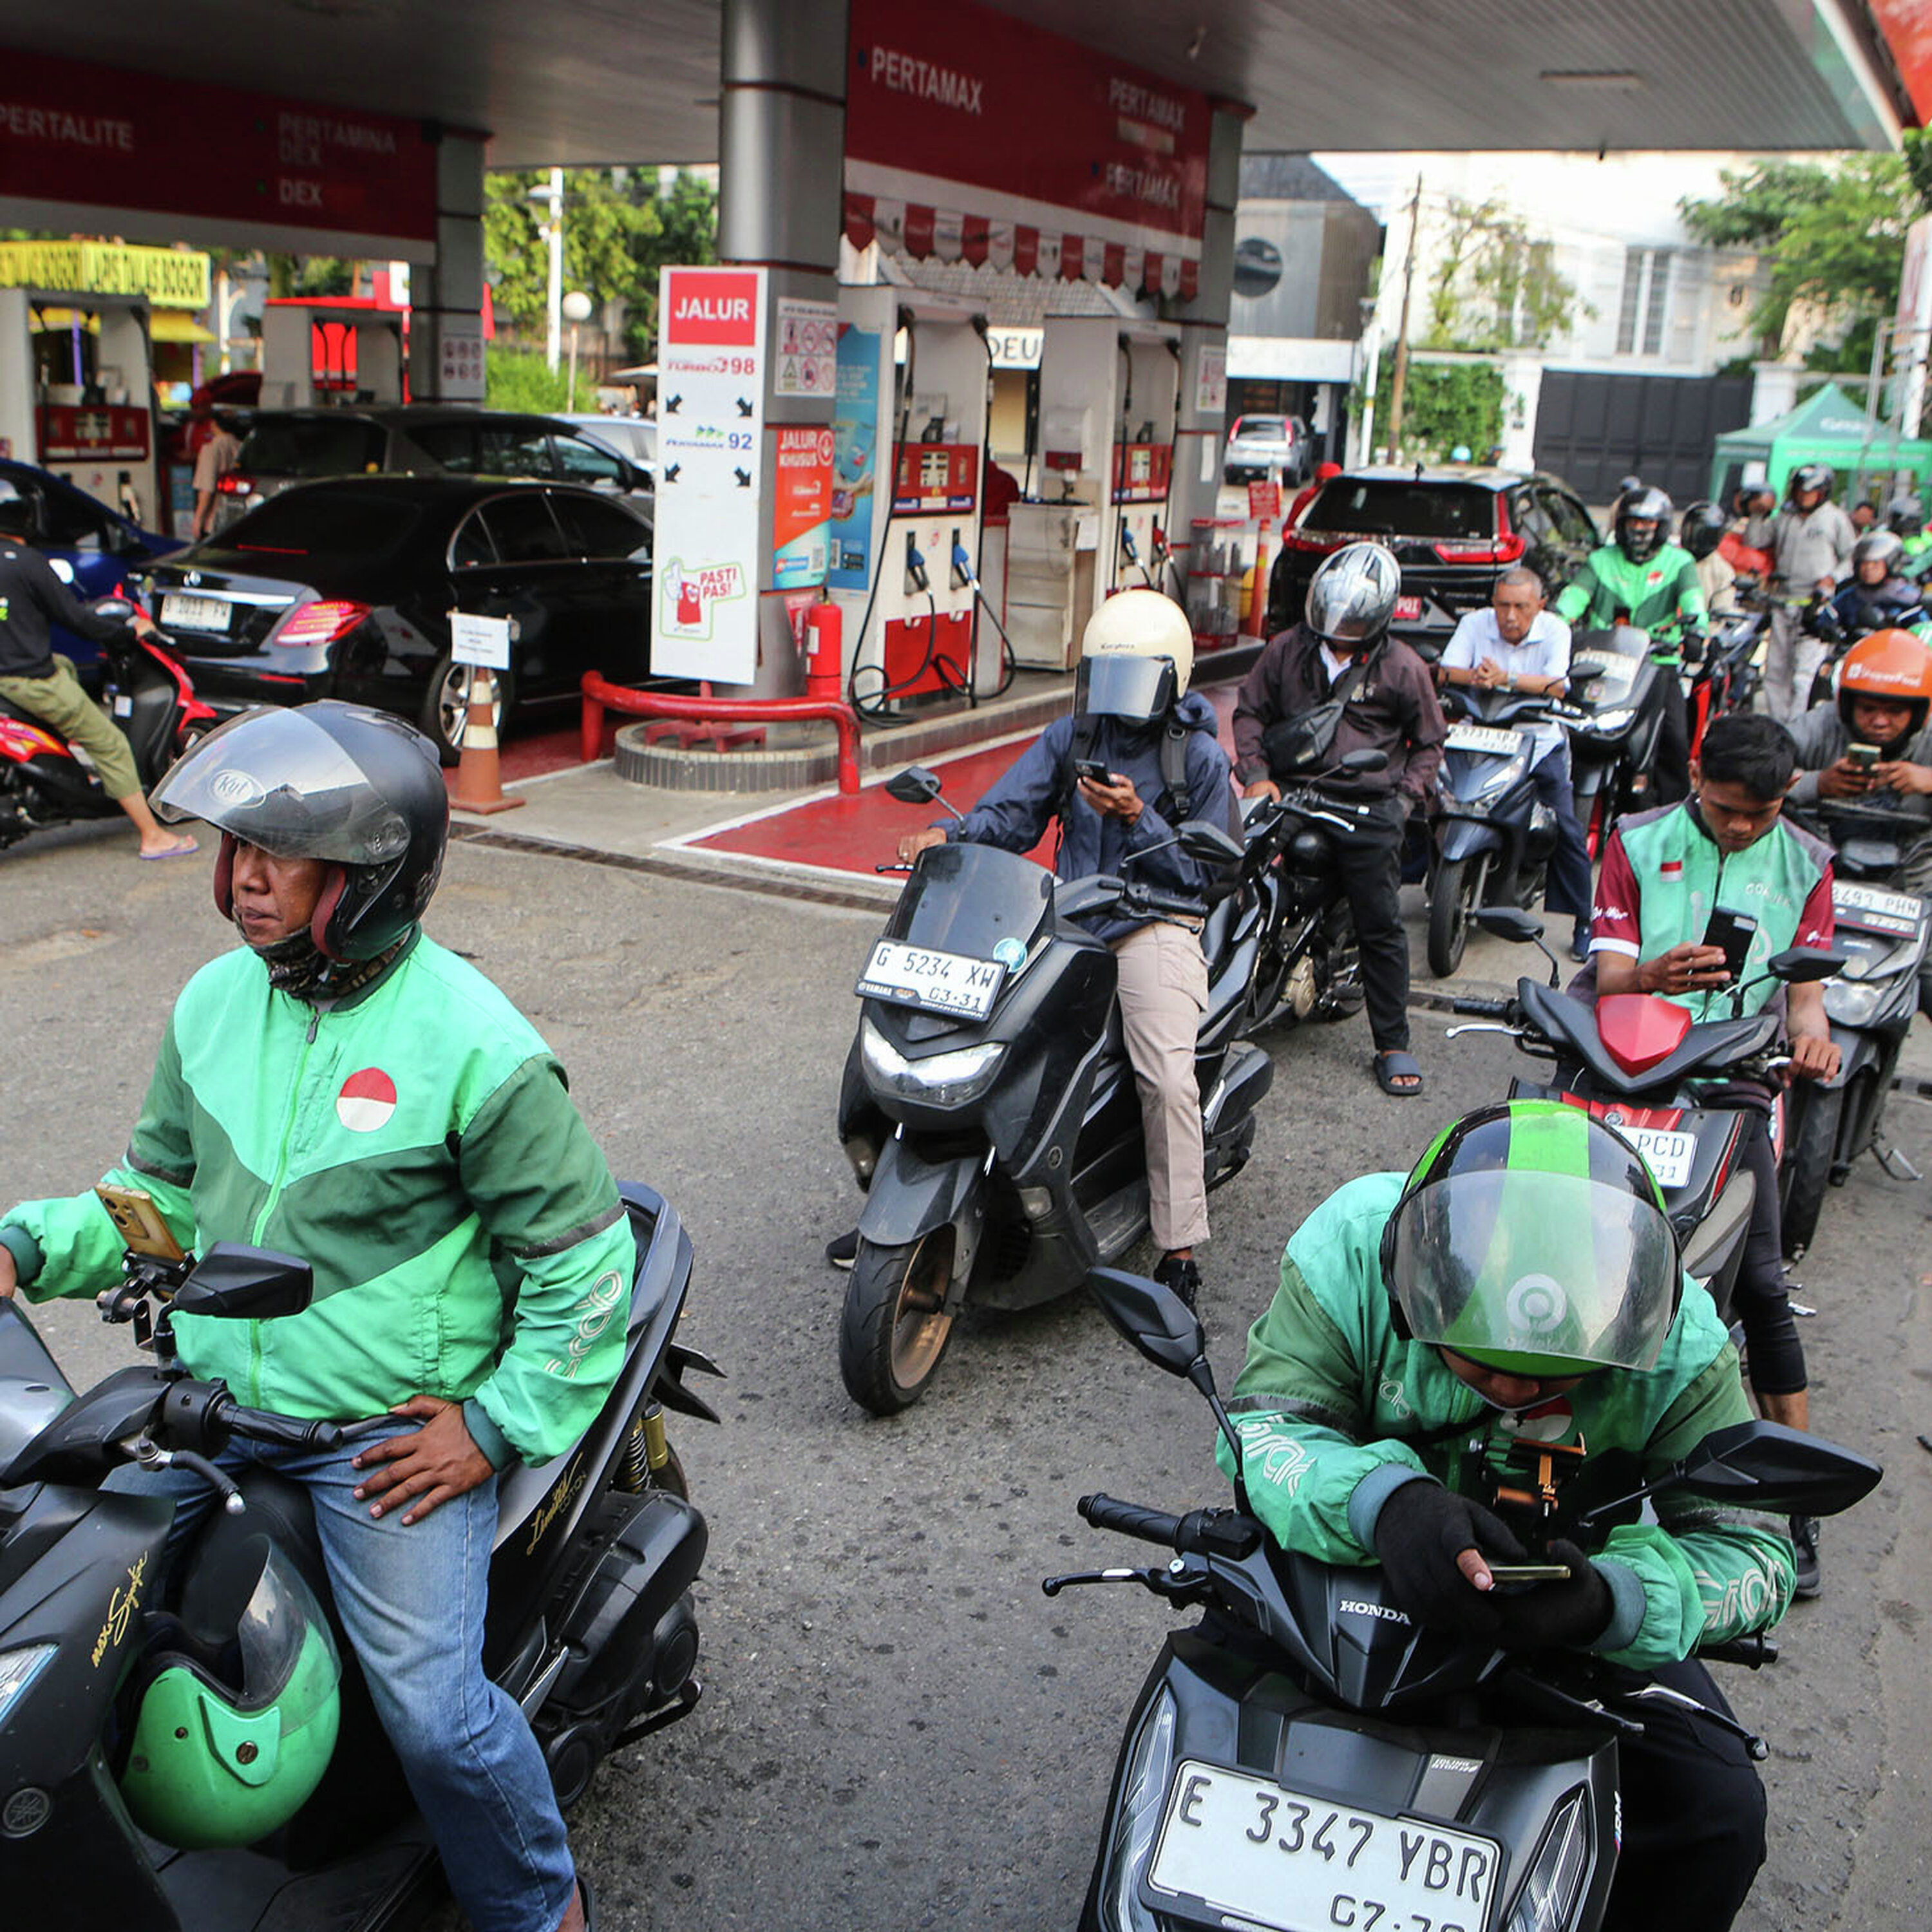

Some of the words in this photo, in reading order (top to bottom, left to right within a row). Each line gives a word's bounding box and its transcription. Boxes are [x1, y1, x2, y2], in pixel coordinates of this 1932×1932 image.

[872, 46, 983, 116] PERTAMAX
[1108, 77, 1186, 133] PERTAMAX
[278, 111, 397, 154] PERTAMINA
[279, 178, 323, 207] DEX
[1106, 162, 1180, 211] PERTAMAX
[162, 256, 204, 296] BOGOR
[674, 297, 749, 320] JALUR
[731, 357, 755, 375] 98
[728, 432, 752, 450] 92
[780, 431, 817, 450] JALUR
[779, 452, 817, 468] KHUSUS
[700, 567, 737, 585] PASTI
[703, 583, 732, 600] PAS!
[876, 947, 891, 967] G
[904, 952, 952, 980] 5234
[965, 965, 996, 989] XW
[1638, 1134, 1685, 1158] PCD
[526, 1451, 584, 1557] Limited
[1340, 1600, 1412, 1626] HONDA
[1179, 1775, 1212, 1826] E
[1246, 1792, 1375, 1868] 3347
[1400, 1830, 1488, 1902] YBR
